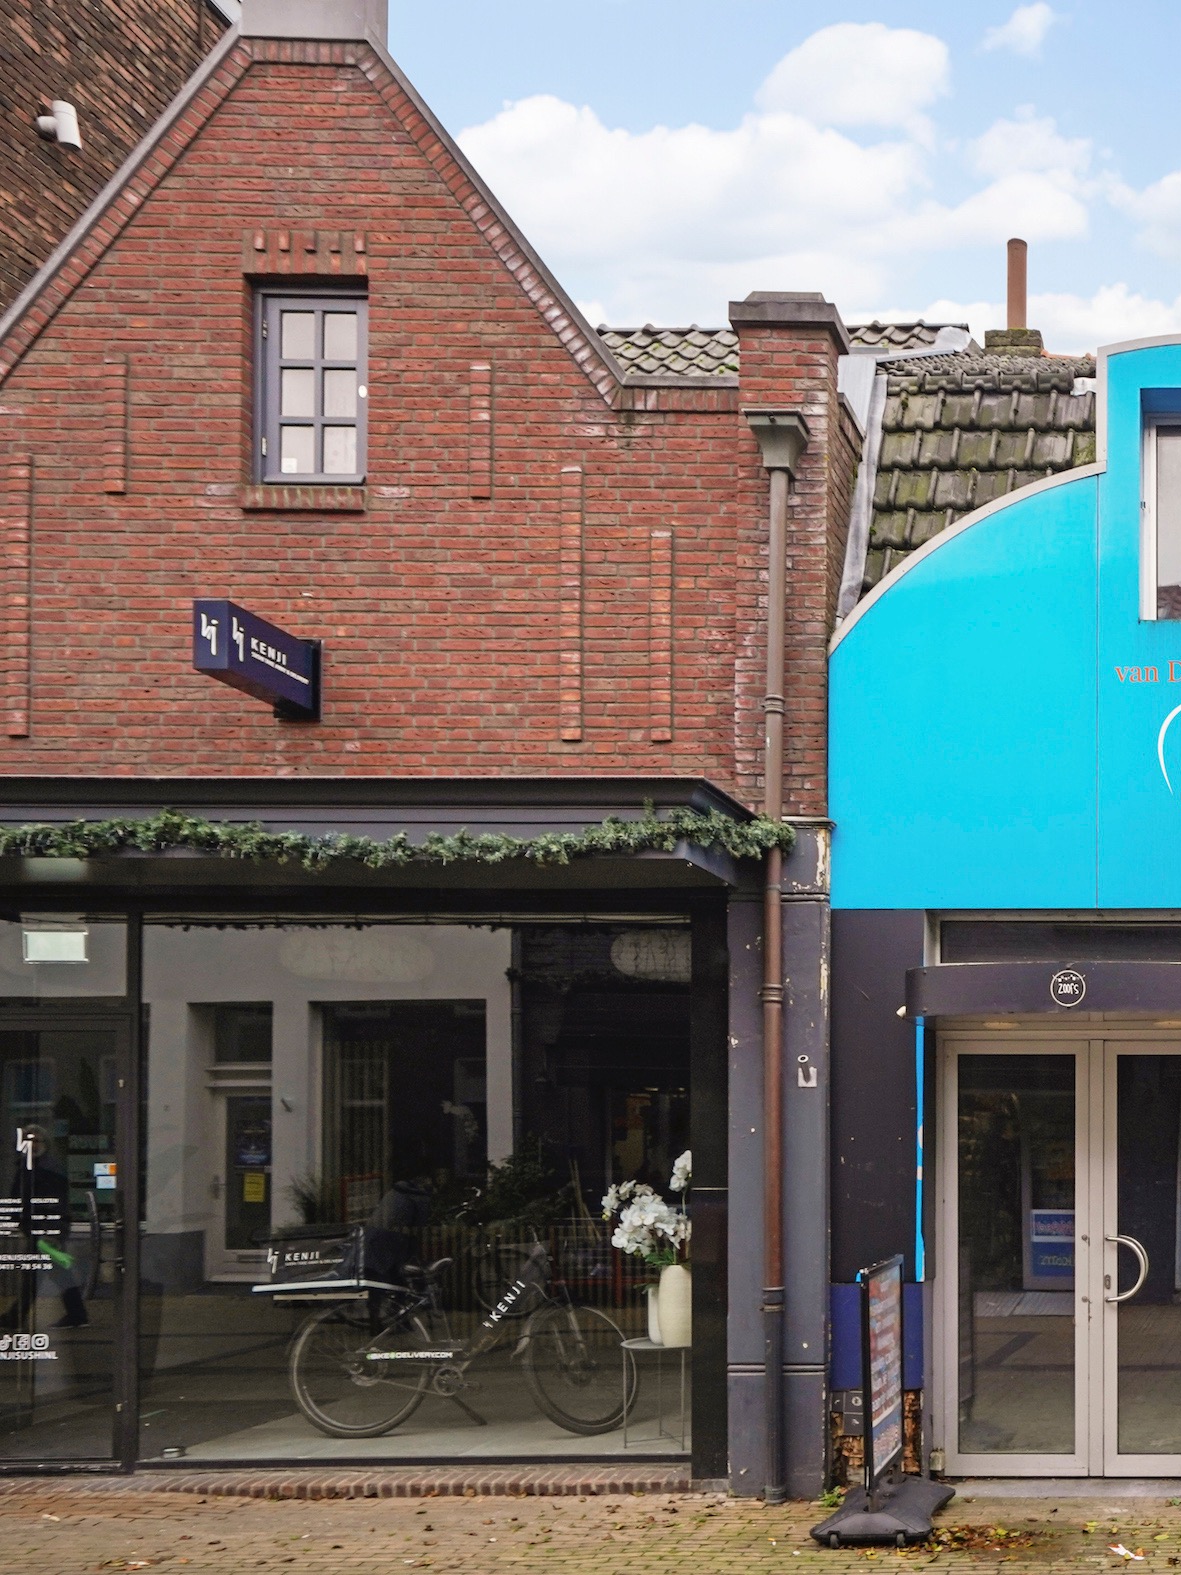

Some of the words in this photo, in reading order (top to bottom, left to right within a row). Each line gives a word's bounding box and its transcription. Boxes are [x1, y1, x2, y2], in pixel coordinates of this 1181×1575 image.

[251, 637, 287, 666] KENJI
[1115, 666, 1159, 682] van
[284, 1251, 320, 1262] KENJI
[489, 1280, 526, 1322] KENJI
